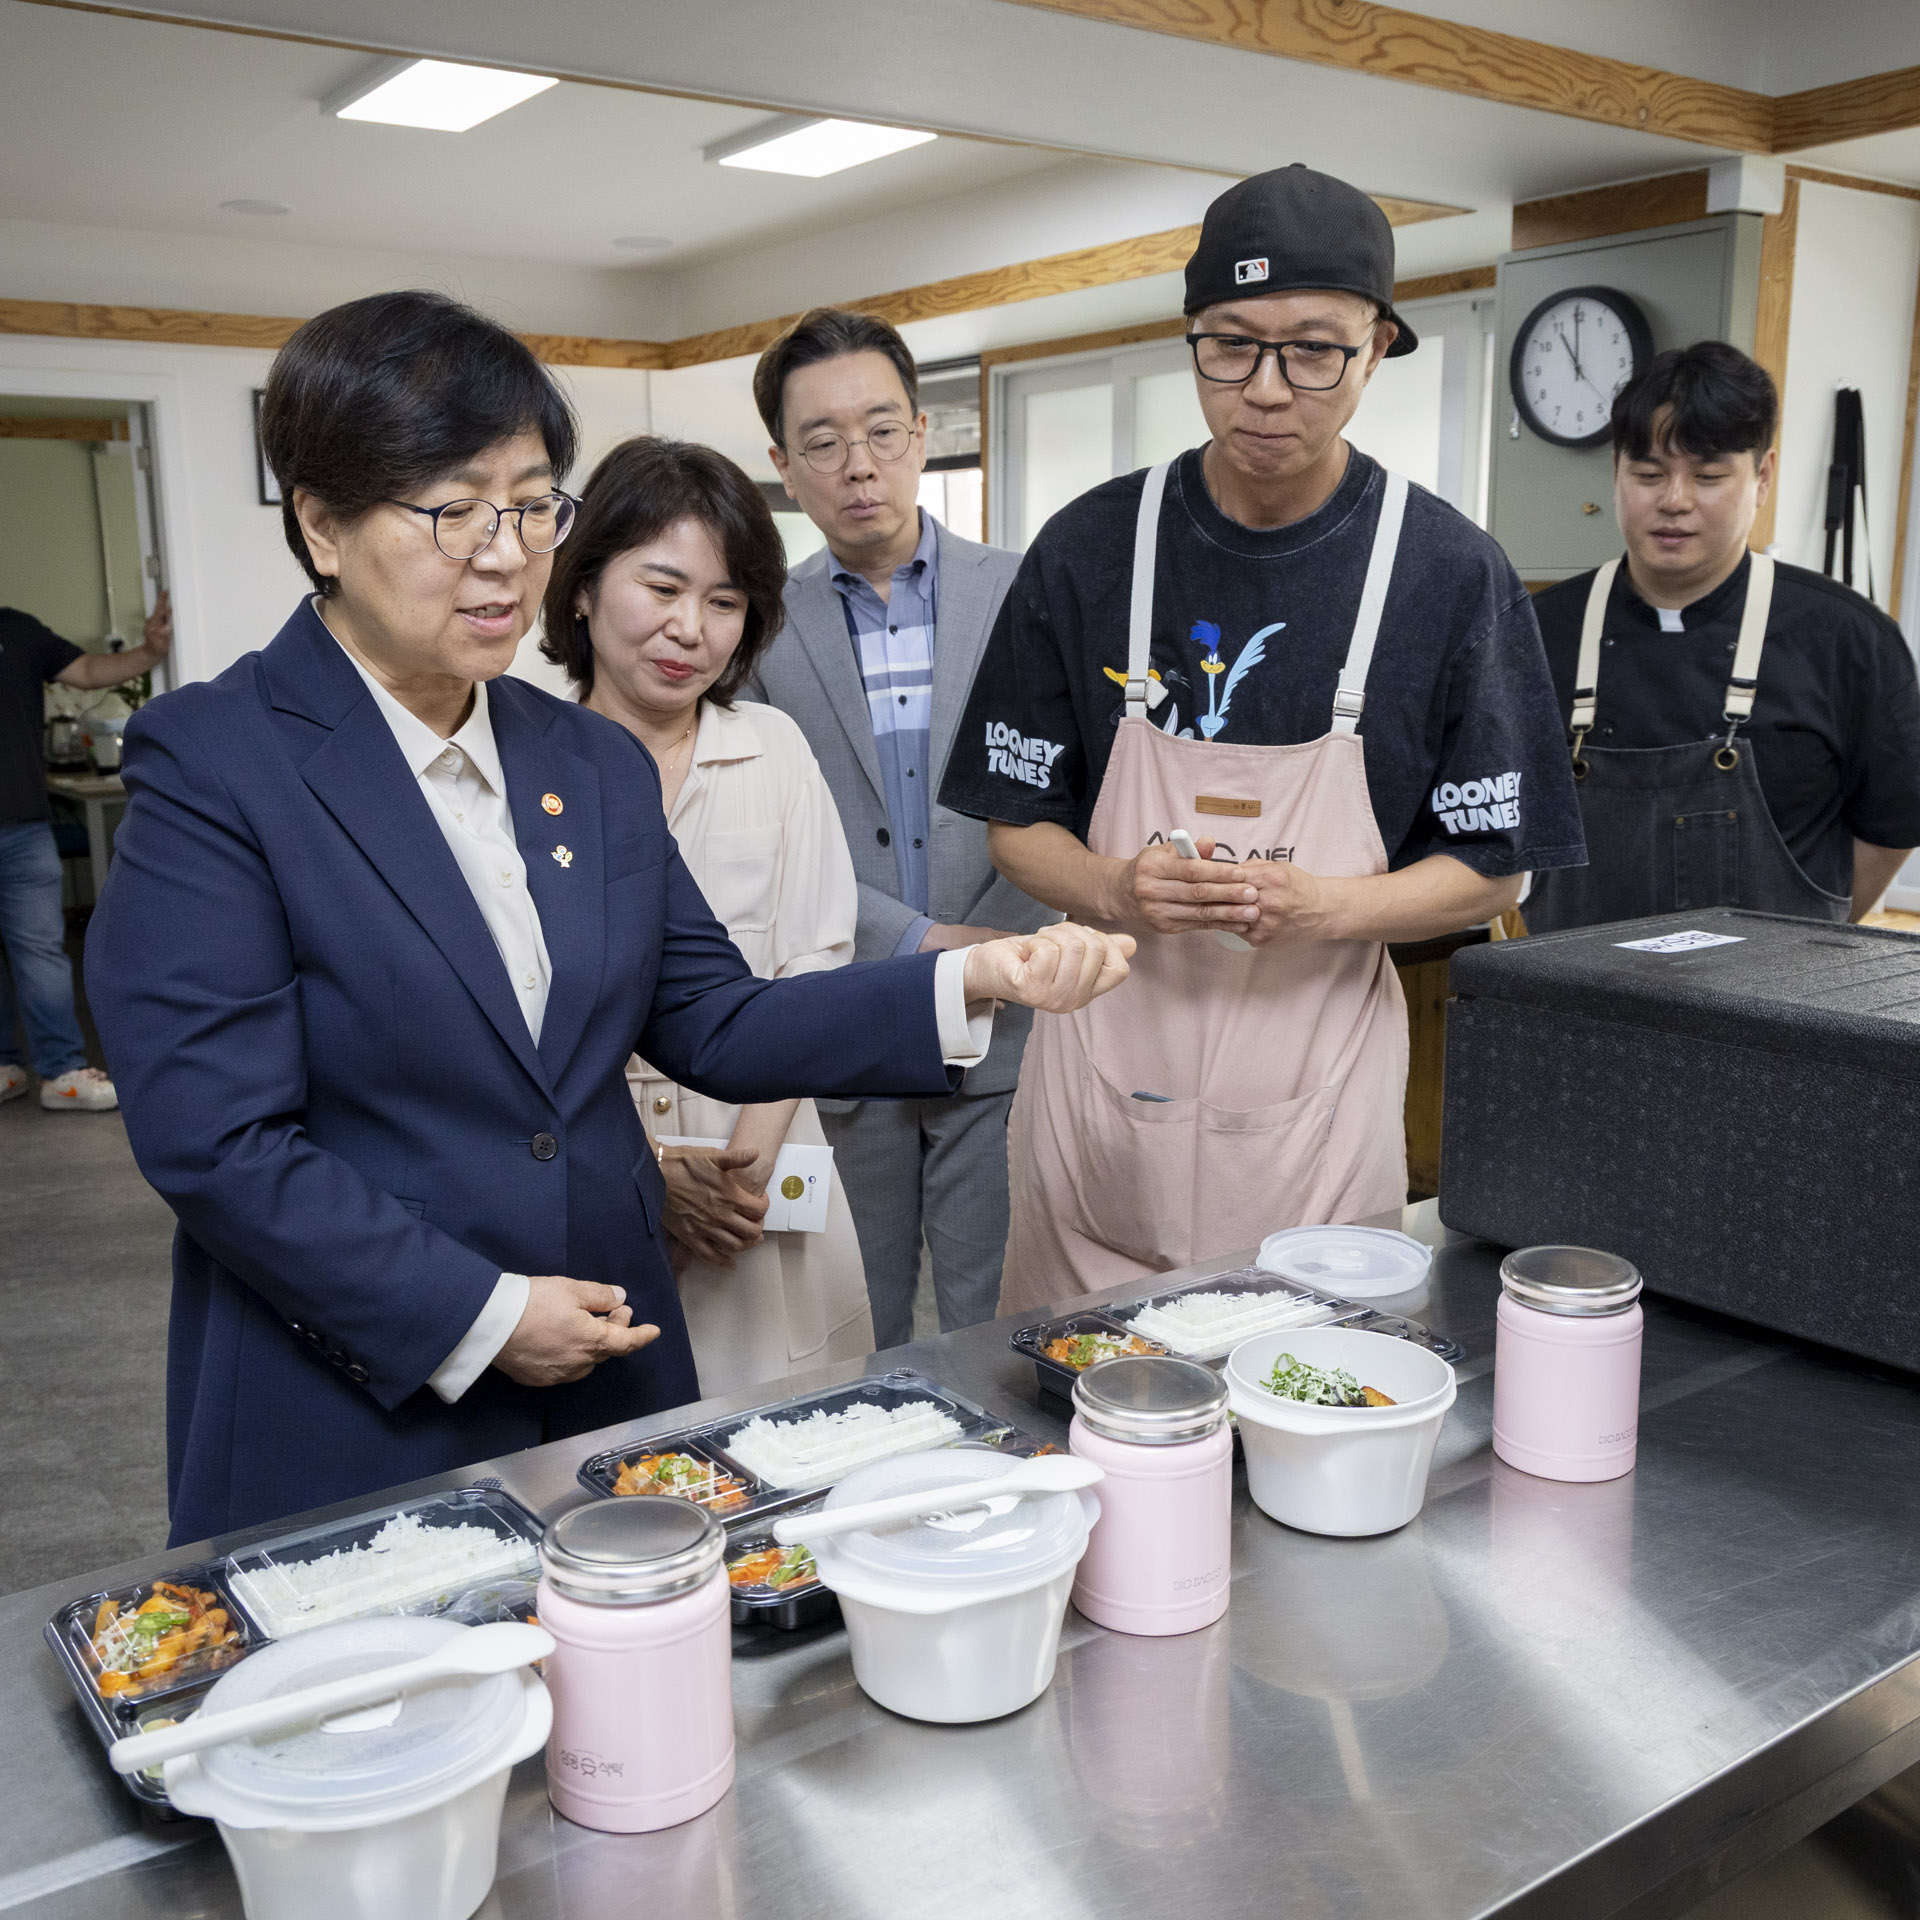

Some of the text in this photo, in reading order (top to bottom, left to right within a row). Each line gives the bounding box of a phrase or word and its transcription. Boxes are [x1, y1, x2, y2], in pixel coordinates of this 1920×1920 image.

[1554, 322, 1564, 333] 11
[1612, 333, 1619, 344] 2
[1540, 341, 1552, 352] 10
[1619, 357, 1626, 368] 3
[1535, 366, 1541, 376] 9
[1540, 389, 1547, 399] 8
[1555, 405, 1561, 416] 7
[1597, 402, 1604, 413] 5
[1576, 411, 1583, 422] 6
[985, 721, 1065, 767] LOONEY
[988, 747, 1050, 789] TUNES
[1432, 771, 1522, 813] LOONEY
[1439, 798, 1520, 835] TUNES
